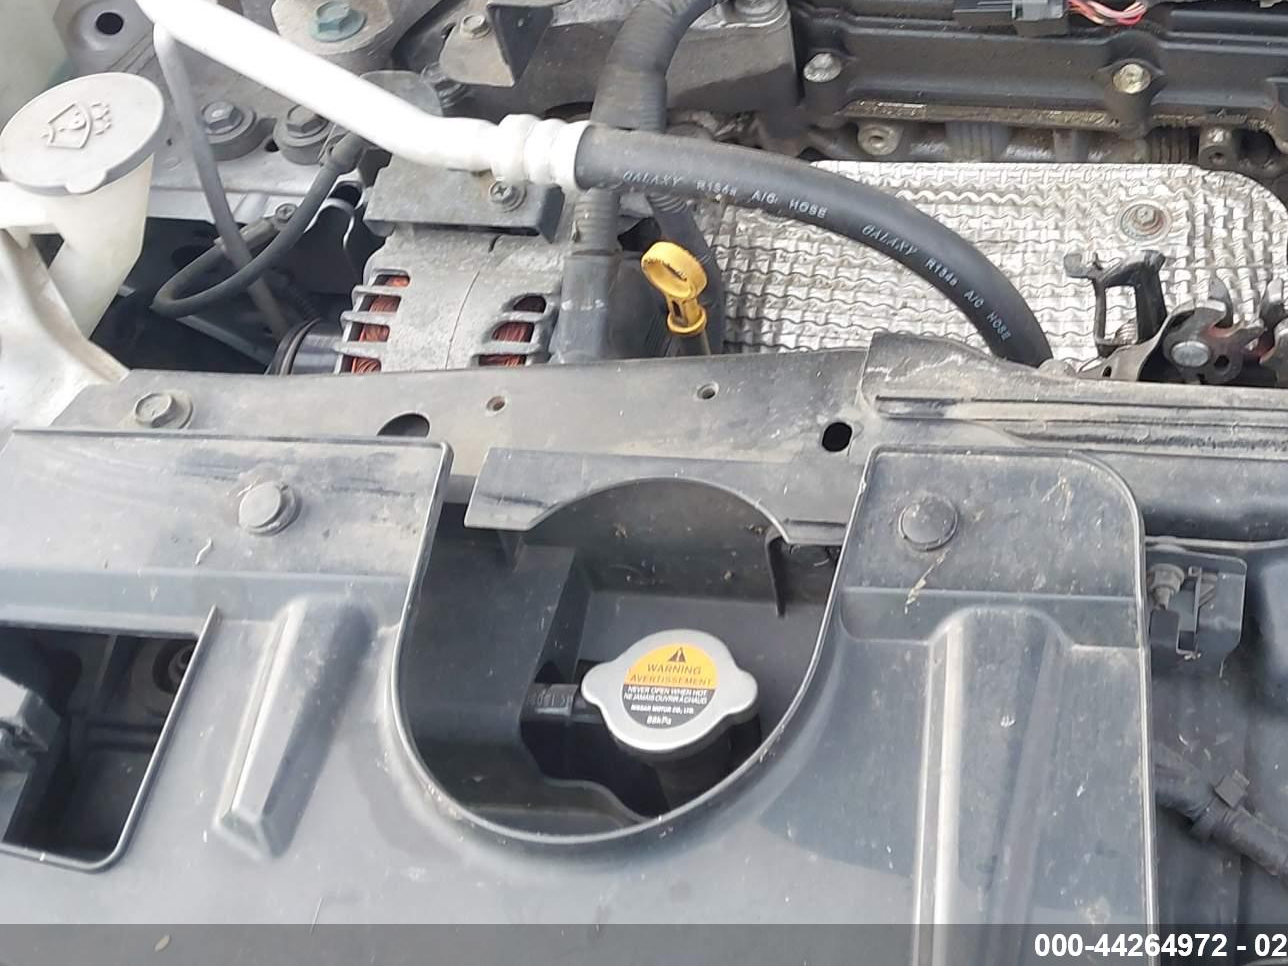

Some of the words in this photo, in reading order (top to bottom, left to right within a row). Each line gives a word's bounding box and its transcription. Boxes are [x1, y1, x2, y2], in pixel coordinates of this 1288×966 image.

[622, 170, 685, 186] GALAXY
[788, 199, 829, 220] HOSE
[861, 223, 919, 257] GALAXY
[963, 289, 986, 310] A/C
[985, 311, 1013, 342] HOSE
[647, 663, 702, 675] WARNING
[630, 674, 713, 686] AVERTISSEMENT
[628, 686, 651, 694] NEVER
[651, 687, 670, 695] OPEN
[630, 704, 652, 712] NISSAN
[652, 705, 672, 713] MOTOR
